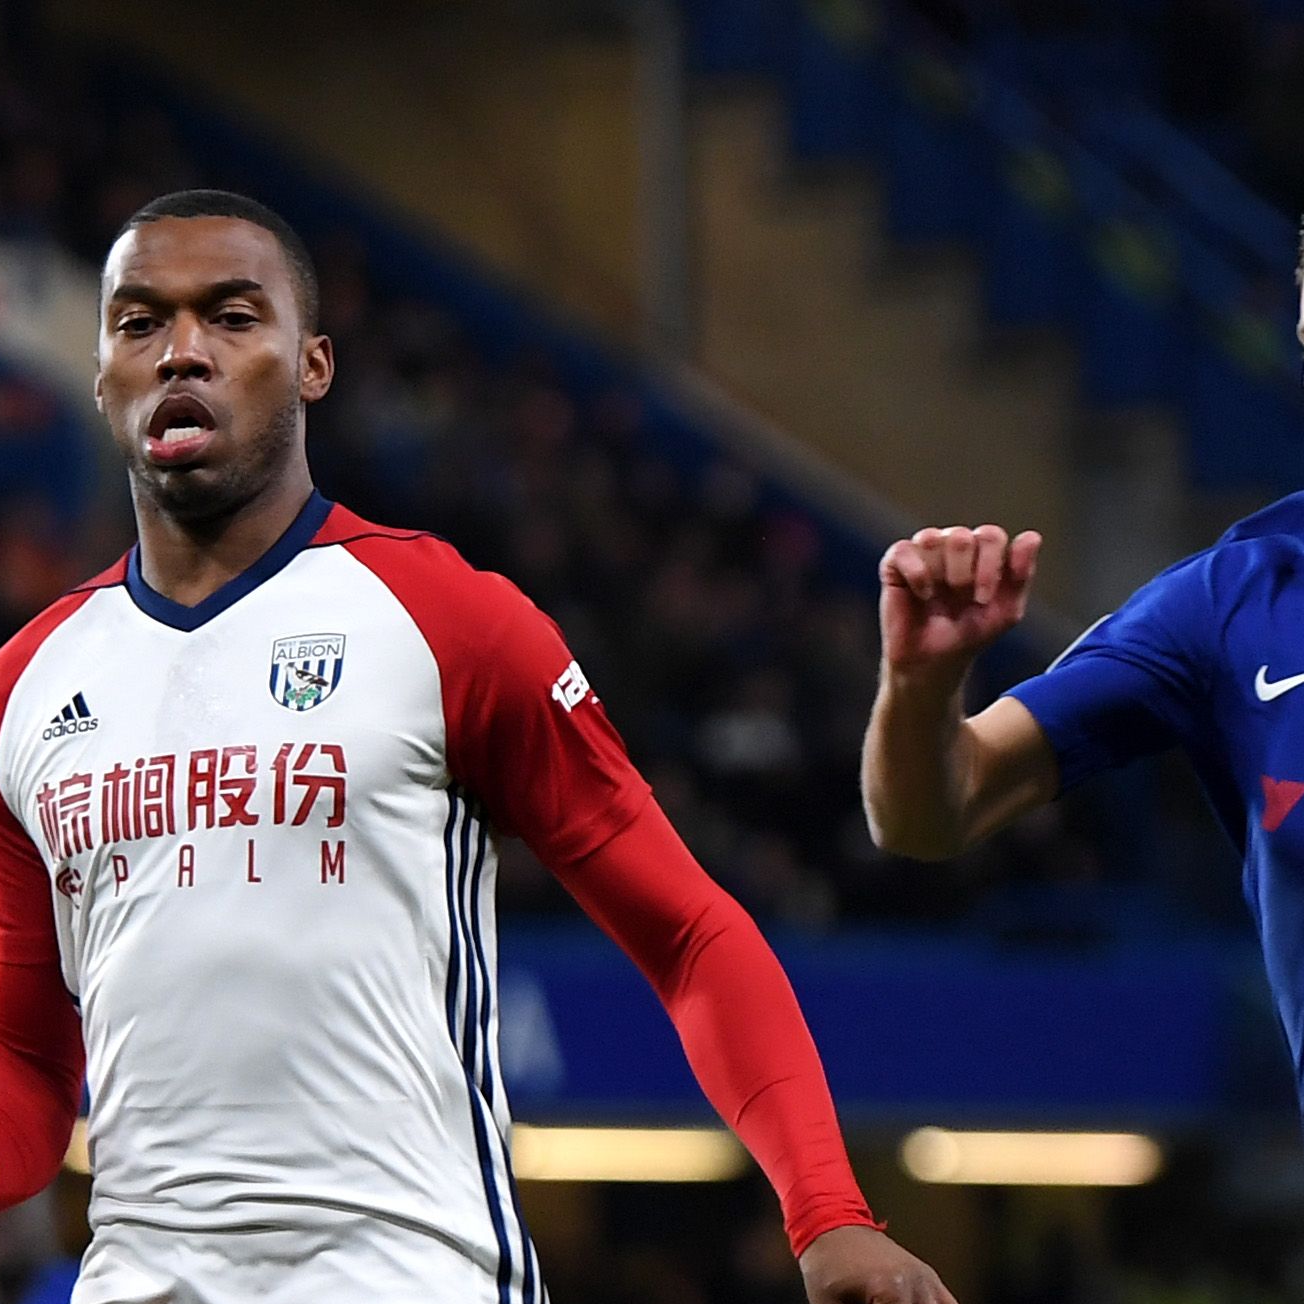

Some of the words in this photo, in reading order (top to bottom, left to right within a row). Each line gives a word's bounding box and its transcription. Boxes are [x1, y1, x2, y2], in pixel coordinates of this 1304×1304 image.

[275, 643, 341, 661] ALBION
[41, 717, 99, 741] adidas
[35, 742, 348, 862] 棕榈股份
